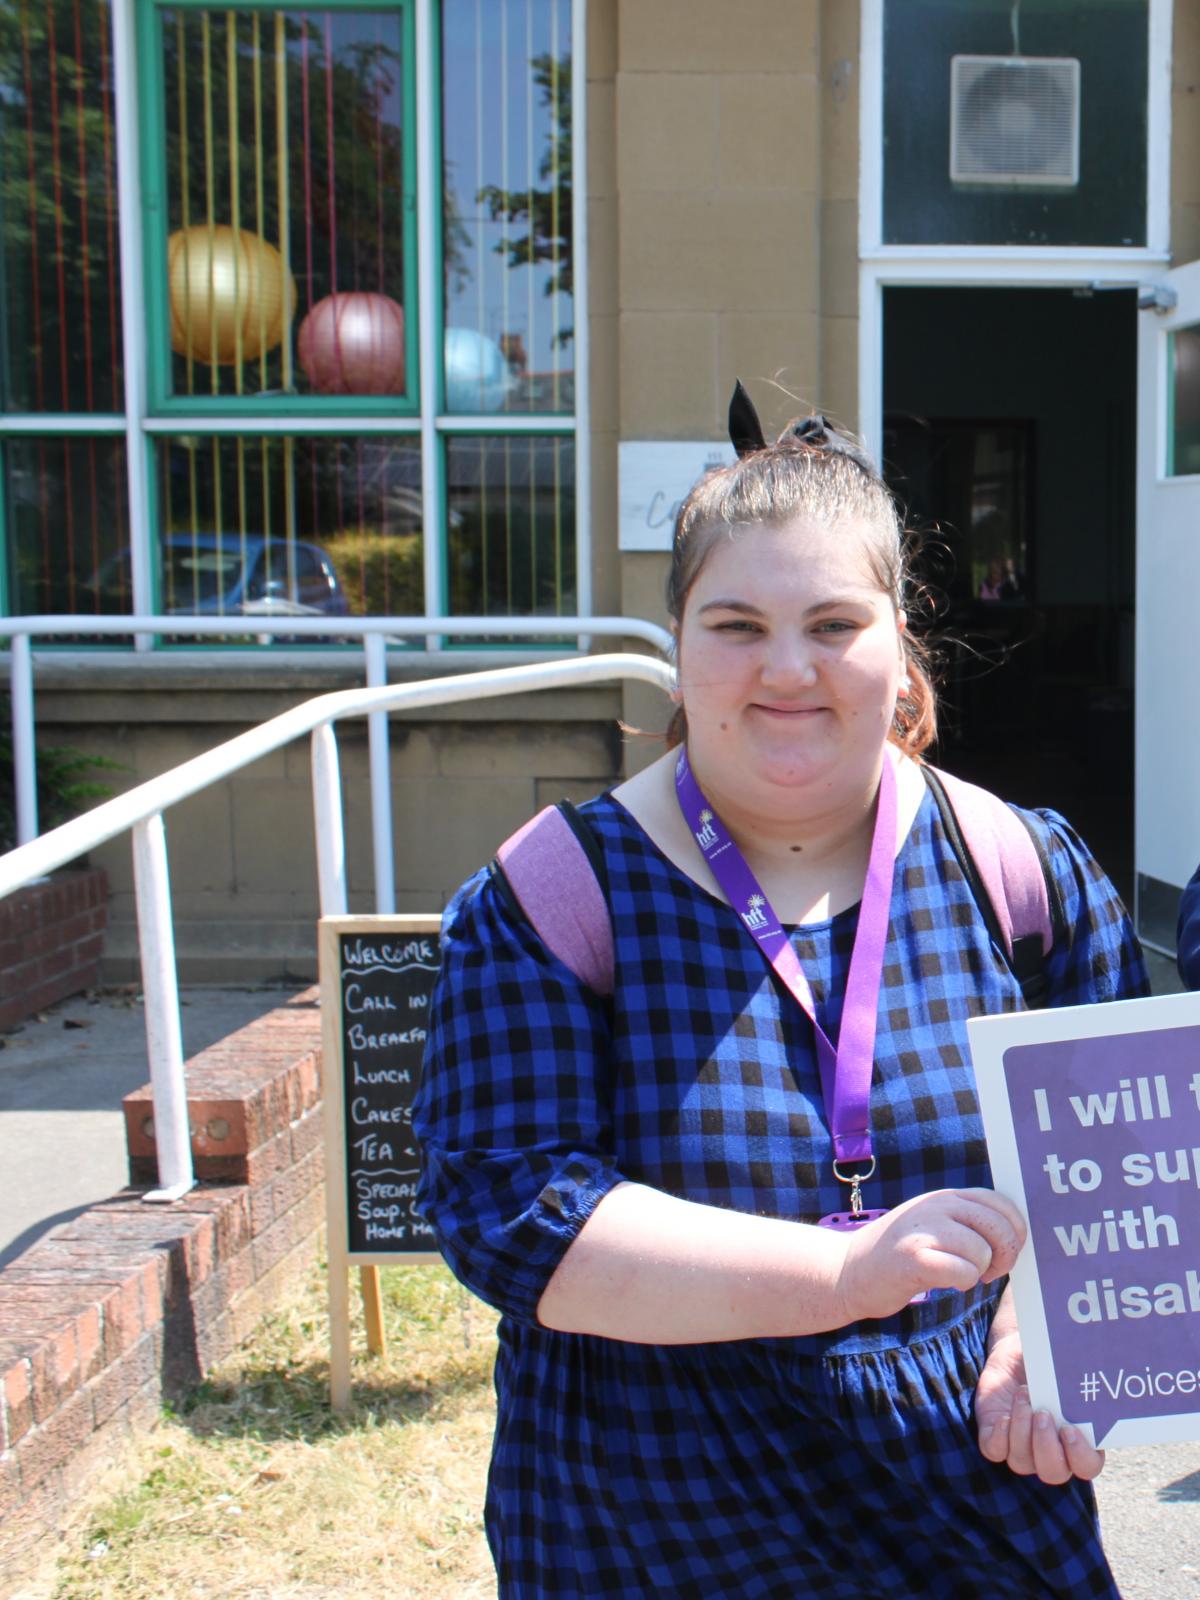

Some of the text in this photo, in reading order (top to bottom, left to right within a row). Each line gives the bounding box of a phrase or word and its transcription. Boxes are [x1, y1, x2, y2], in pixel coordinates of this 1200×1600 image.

[741, 907, 767, 926] hft
[344, 939, 433, 964] WELCOME
[345, 984, 428, 1013] CALL IN
[348, 1024, 427, 1050] BREAKFA
[352, 1097, 412, 1125] CAKES
[1034, 1088, 1052, 1132] I
[1068, 1075, 1172, 1127] will
[353, 1133, 394, 1161] TEA
[1043, 1154, 1102, 1194] to
[412, 1223, 433, 1236] MA
[1053, 1205, 1180, 1257] with
